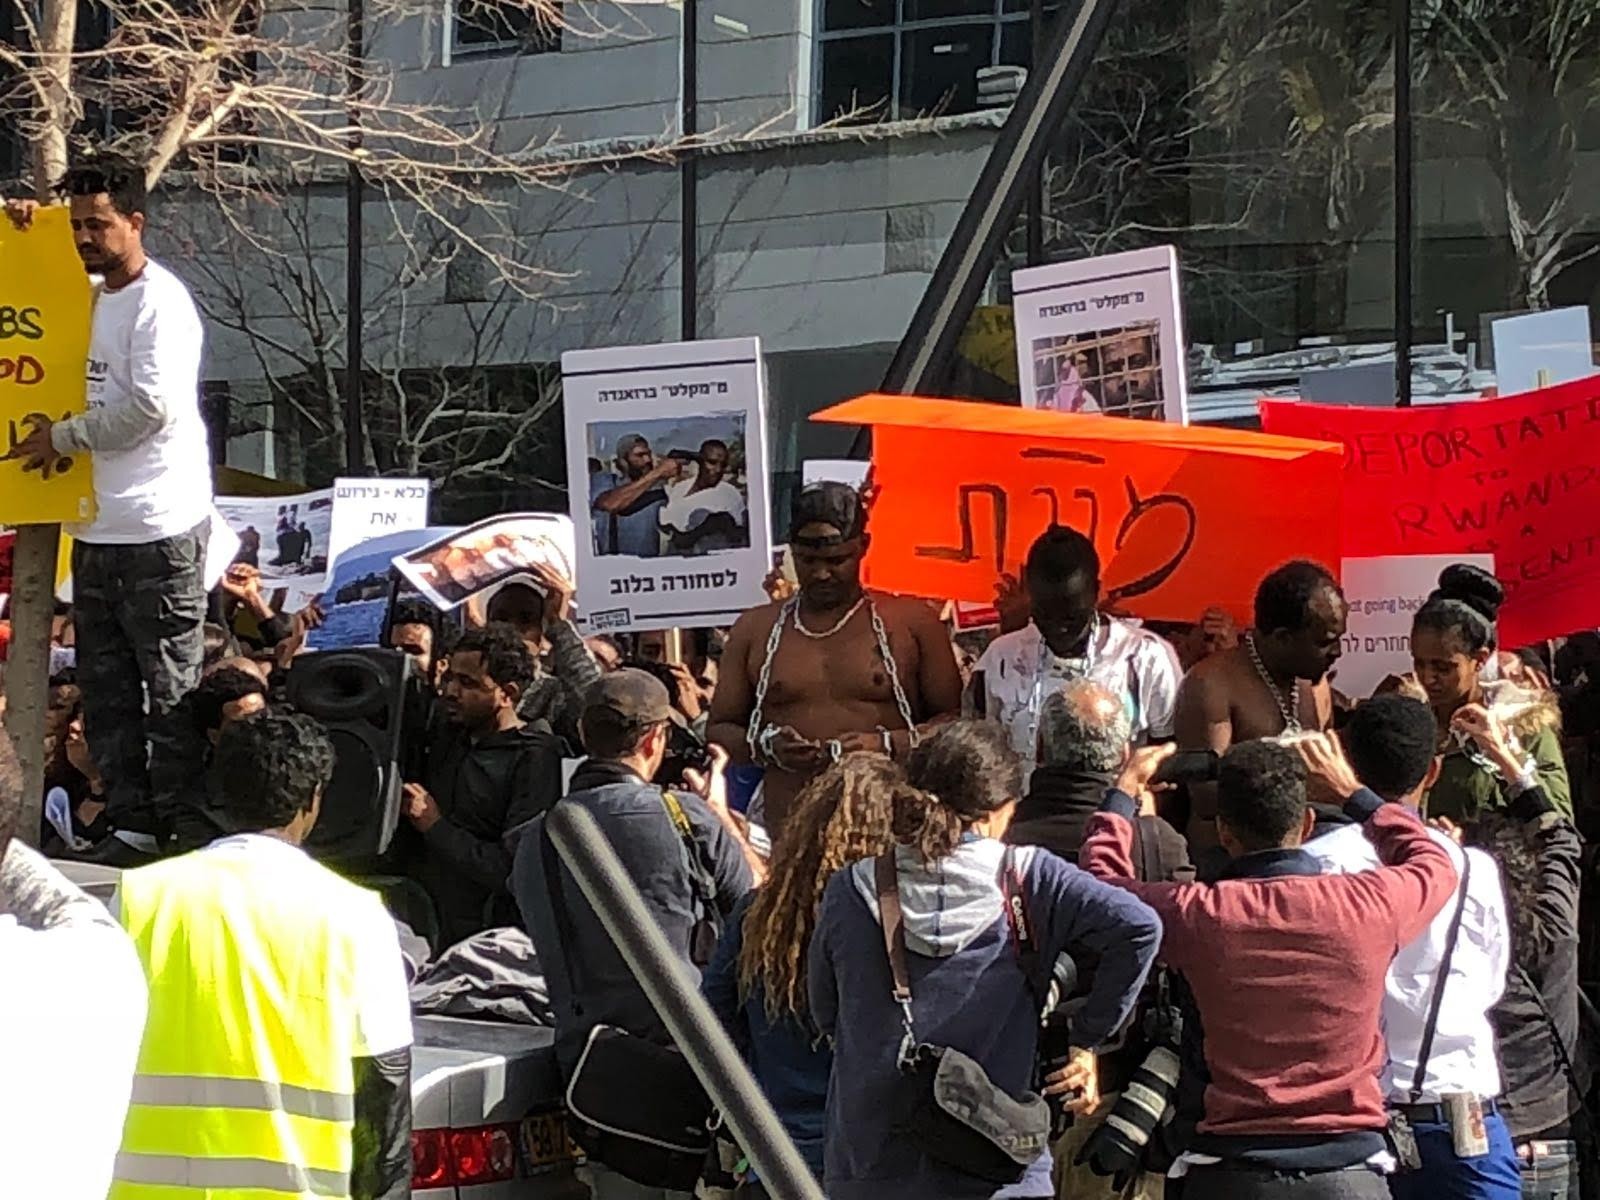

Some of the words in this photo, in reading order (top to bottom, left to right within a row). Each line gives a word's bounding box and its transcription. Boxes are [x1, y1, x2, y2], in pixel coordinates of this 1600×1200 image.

[598, 387, 657, 402] ברואנדה
[370, 512, 397, 526] את
[610, 574, 655, 595] בלוב
[661, 568, 738, 591] לסחורה
[1365, 599, 1396, 615] going
